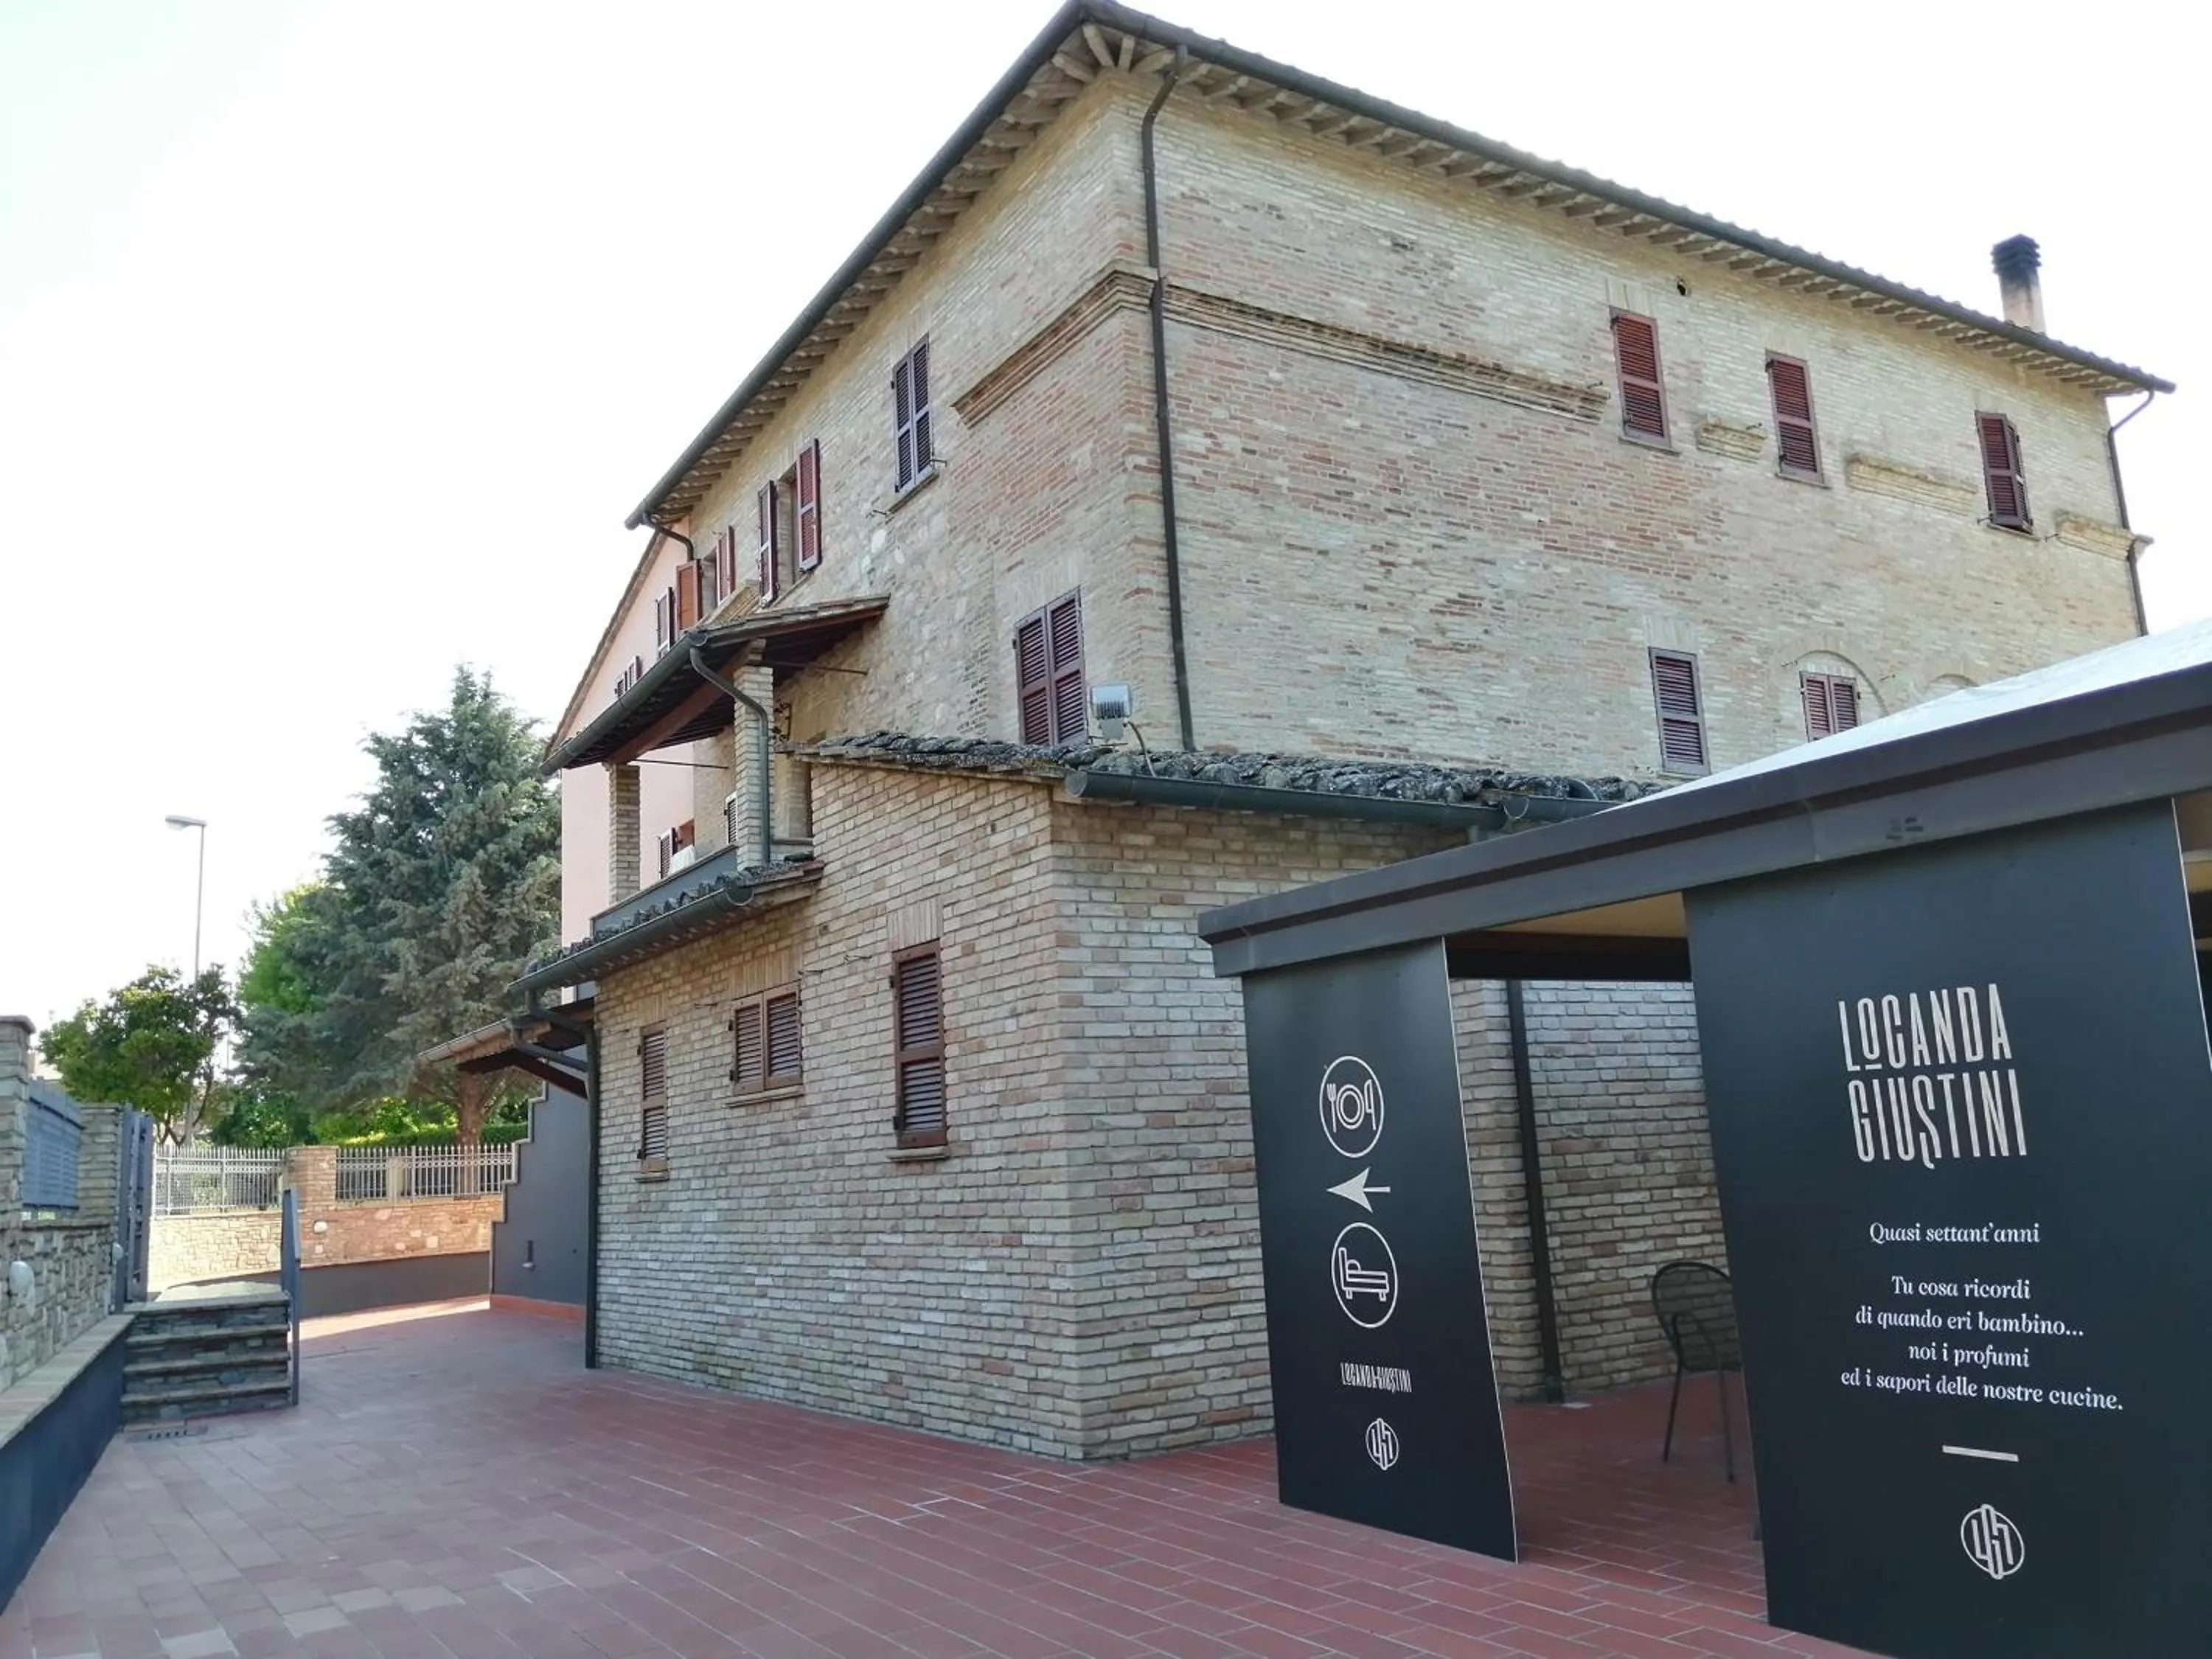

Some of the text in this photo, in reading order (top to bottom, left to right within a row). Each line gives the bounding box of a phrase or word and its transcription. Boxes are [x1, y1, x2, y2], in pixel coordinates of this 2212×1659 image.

[1838, 983, 2013, 1071] LOCANDA
[1848, 1068, 2027, 1170] GIUSTINI
[1869, 1222, 1921, 1245] Quasi
[1891, 1276, 2031, 1300] Tu cosa ricordi
[1855, 1305, 2084, 1336] di quando eri bambino...
[1908, 1341, 2031, 1369] noi i profumi
[1840, 1368, 2124, 1411] ed i sapori delle nostre cucine.
